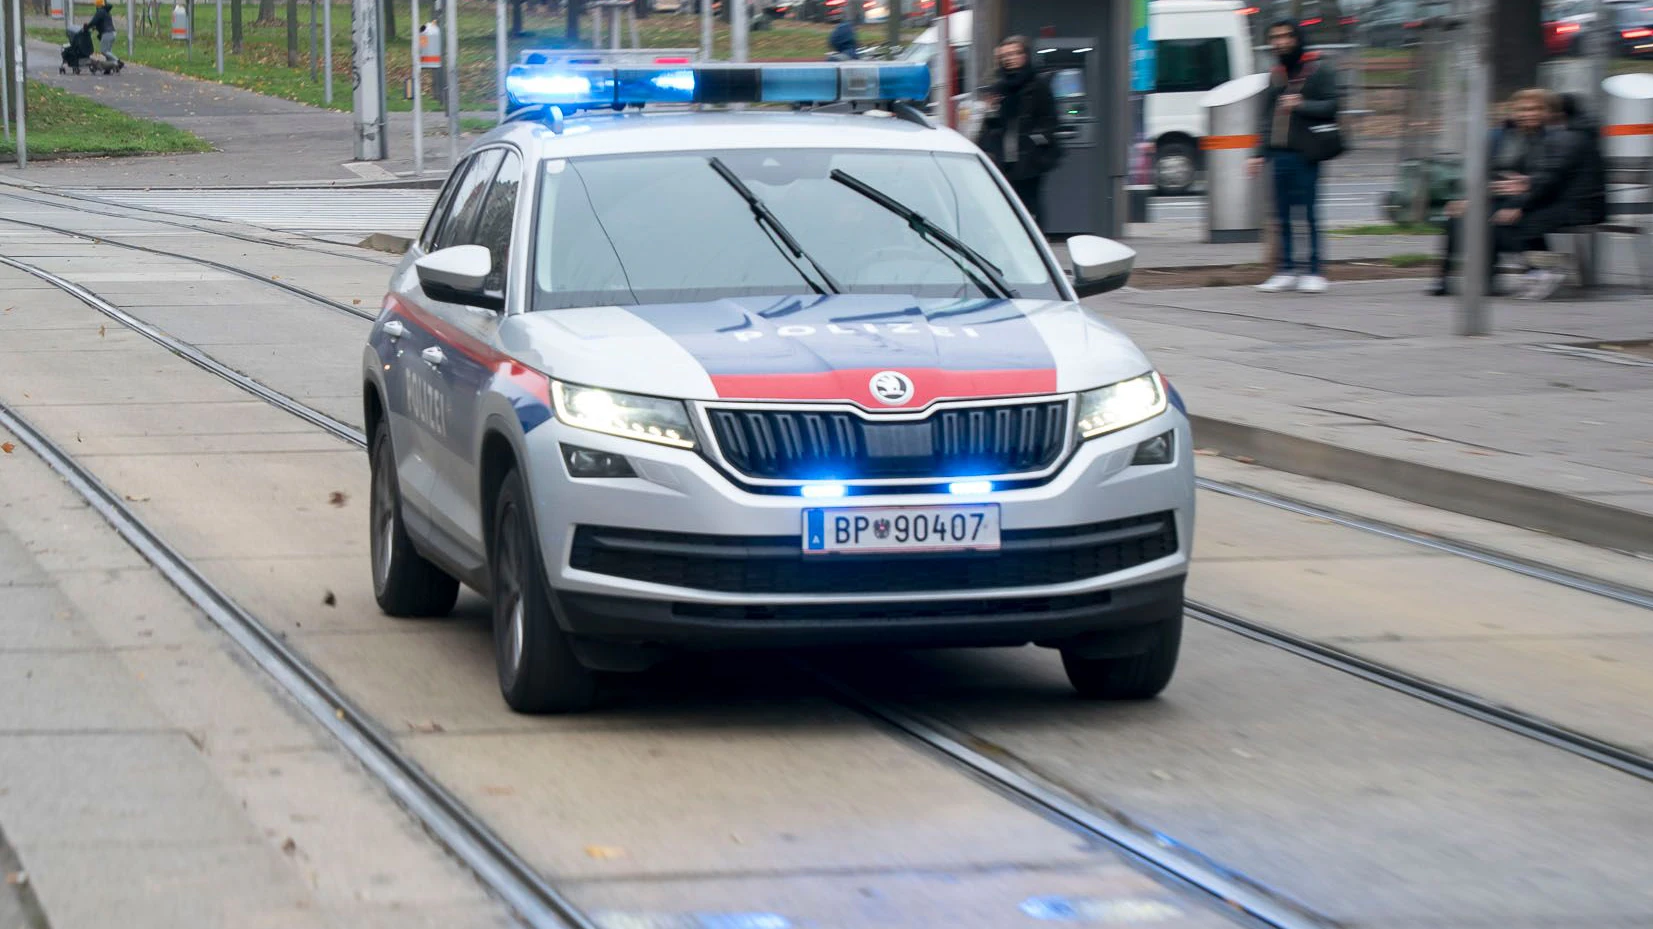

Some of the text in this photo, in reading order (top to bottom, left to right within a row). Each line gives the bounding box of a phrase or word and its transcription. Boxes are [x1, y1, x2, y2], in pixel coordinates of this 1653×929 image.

[732, 322, 980, 342] POLIZEI
[405, 367, 447, 437] POLIZEI
[835, 513, 985, 544] BP 90407
